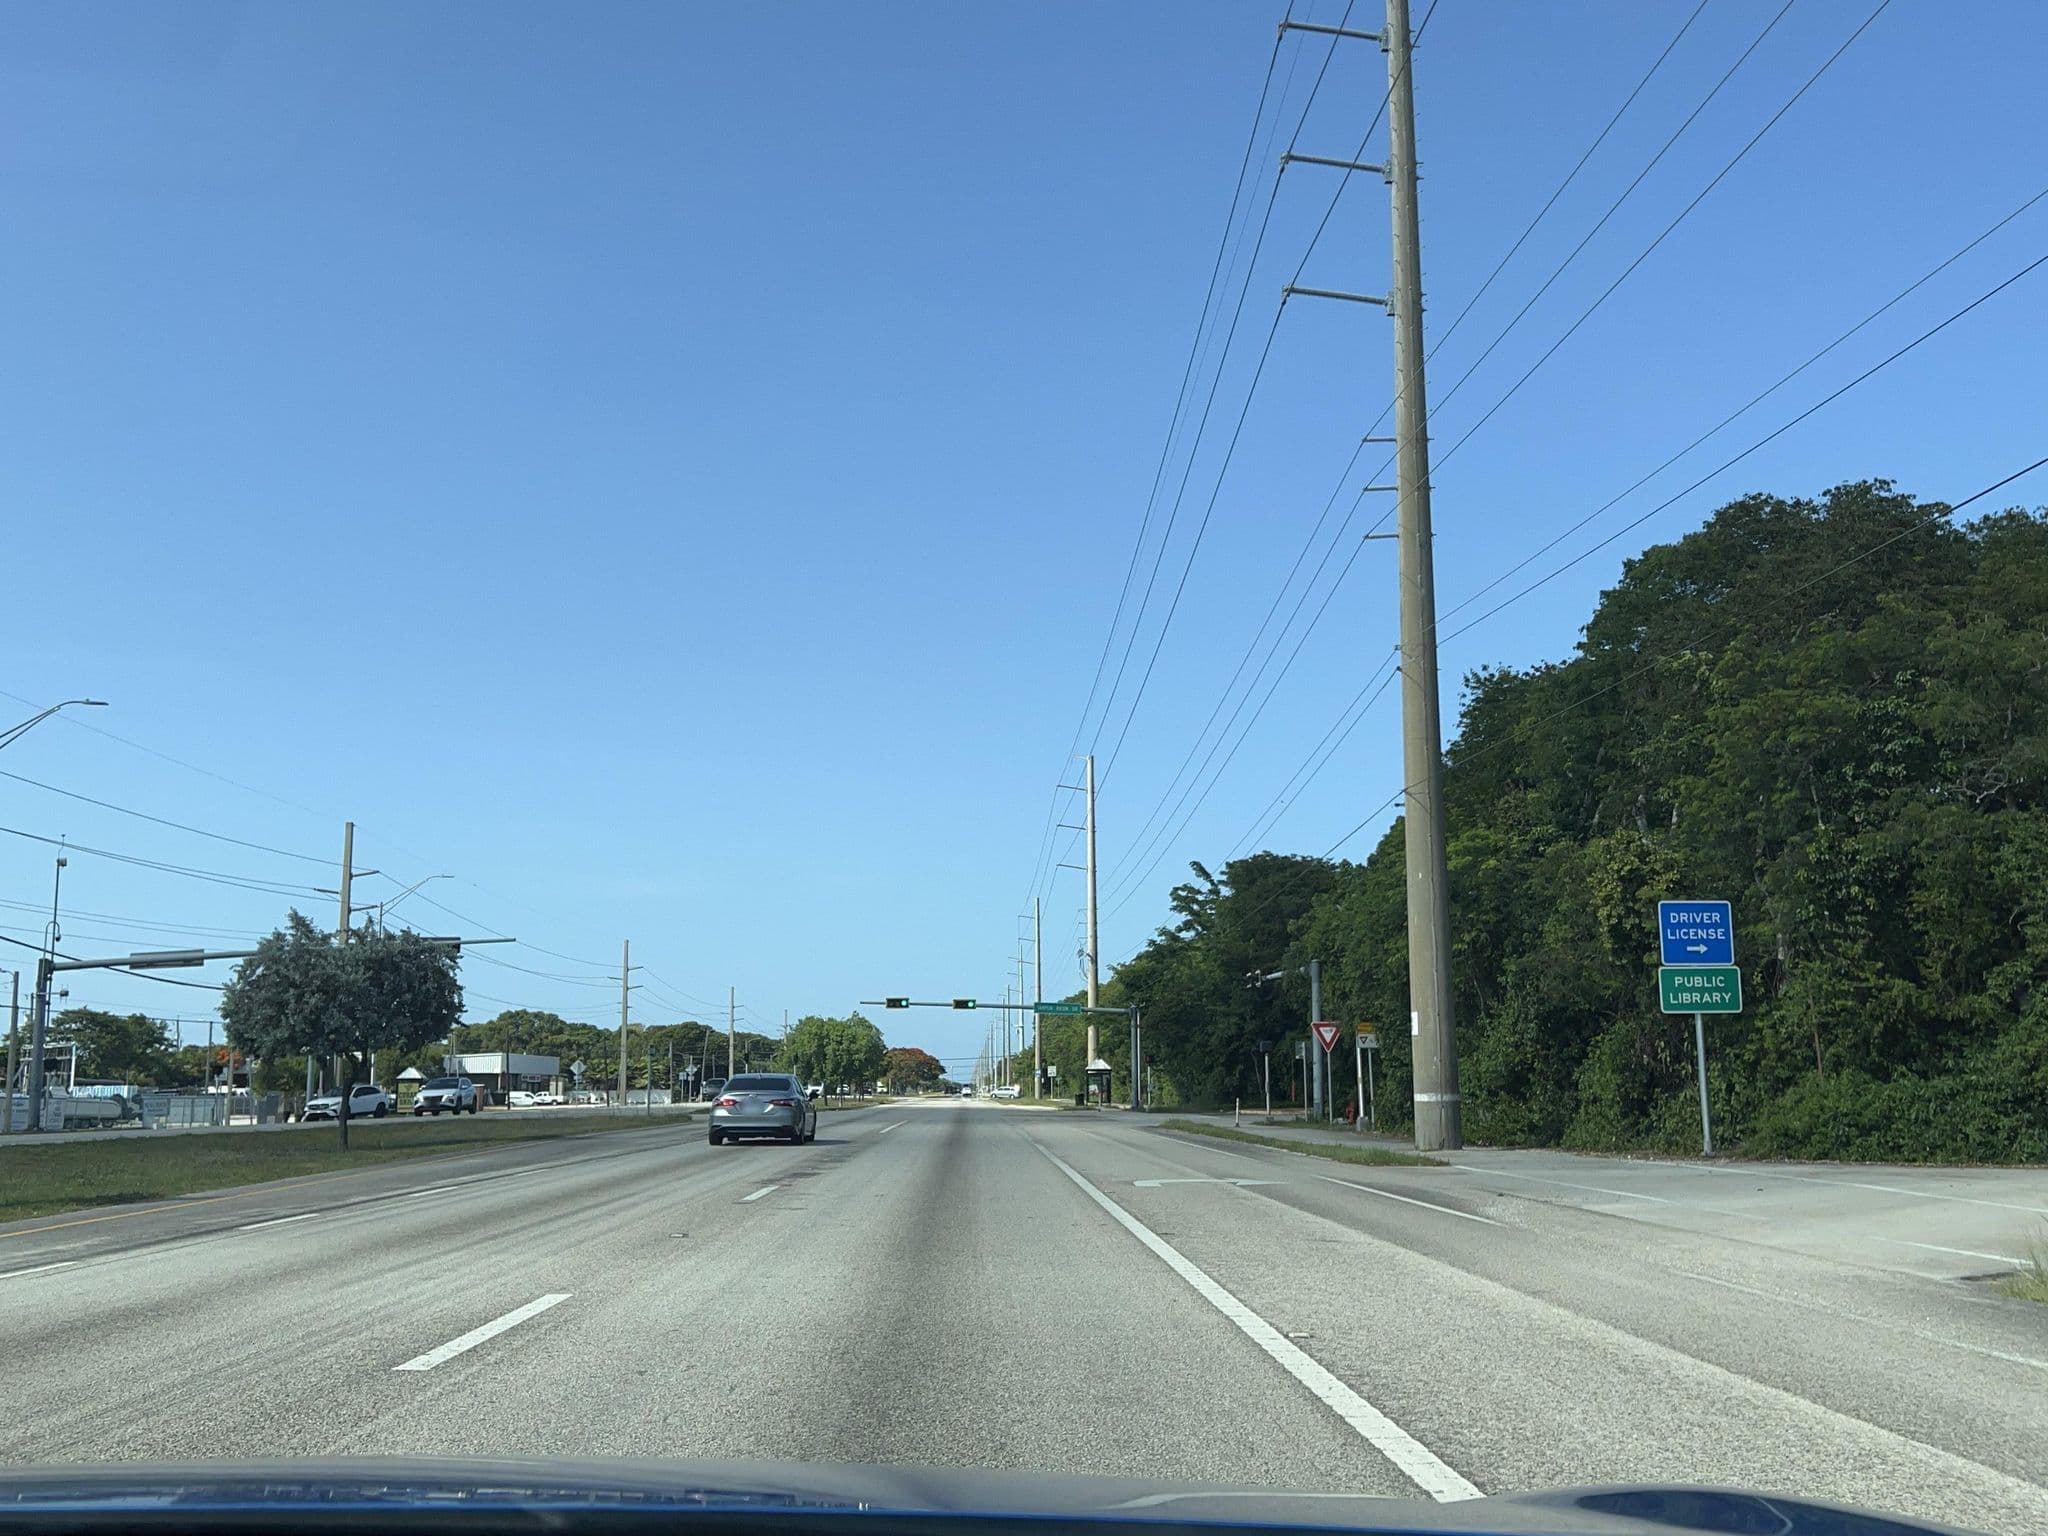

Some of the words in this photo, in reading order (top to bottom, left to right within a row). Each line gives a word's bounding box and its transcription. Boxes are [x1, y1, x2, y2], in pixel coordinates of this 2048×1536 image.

[1670, 912, 1721, 924] DRIVER
[1667, 928, 1726, 940] LICENSE
[1674, 976, 1725, 988] PUBLIC
[1669, 992, 1732, 1004] LIBRARY
